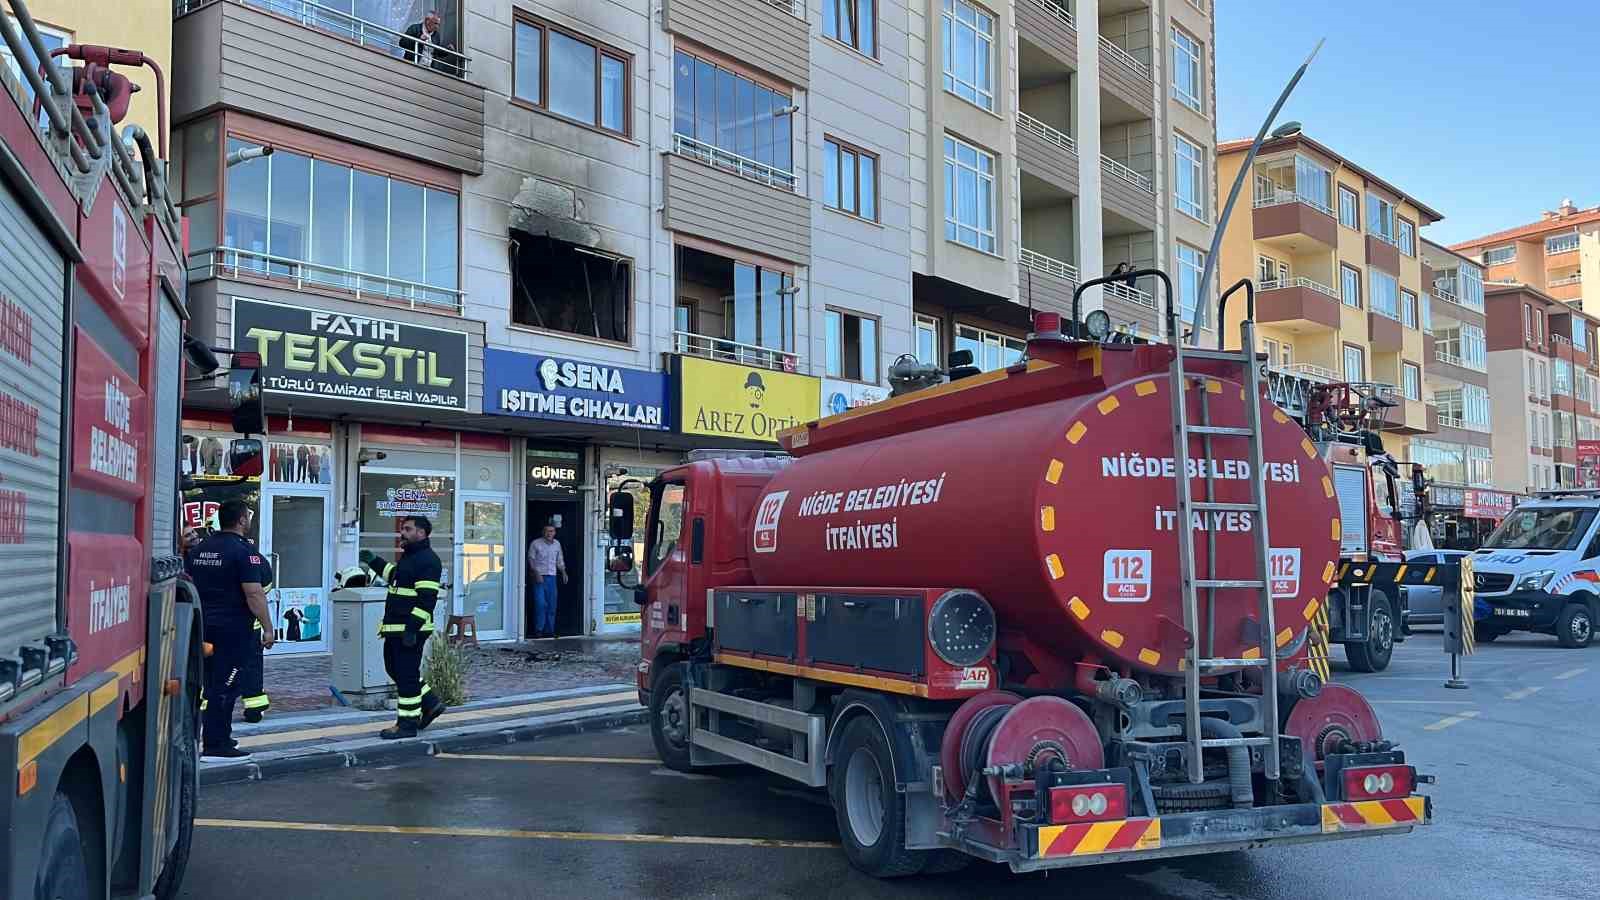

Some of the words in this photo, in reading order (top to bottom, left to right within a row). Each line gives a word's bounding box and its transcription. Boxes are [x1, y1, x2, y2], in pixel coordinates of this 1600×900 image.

[310, 312, 400, 343] FATİH
[245, 327, 454, 388] TEKSTİL
[271, 375, 314, 392] TÜRLÜ
[317, 382, 373, 398] TAMİRAT
[376, 385, 413, 402] İŞLERİ
[415, 391, 459, 406] YAPILIR
[562, 361, 625, 394] SENA
[531, 465, 576, 480] GÜNER
[1101, 452, 1175, 478] NİĞDE
[1186, 458, 1300, 483] BELEDYESİ
[798, 490, 844, 517] NİĞDE
[844, 472, 947, 512] BELEDİYESİ
[760, 499, 780, 525] 112
[826, 517, 899, 551] İTFAİYESİ
[1112, 556, 1144, 579] 112
[1270, 554, 1295, 577] 112
